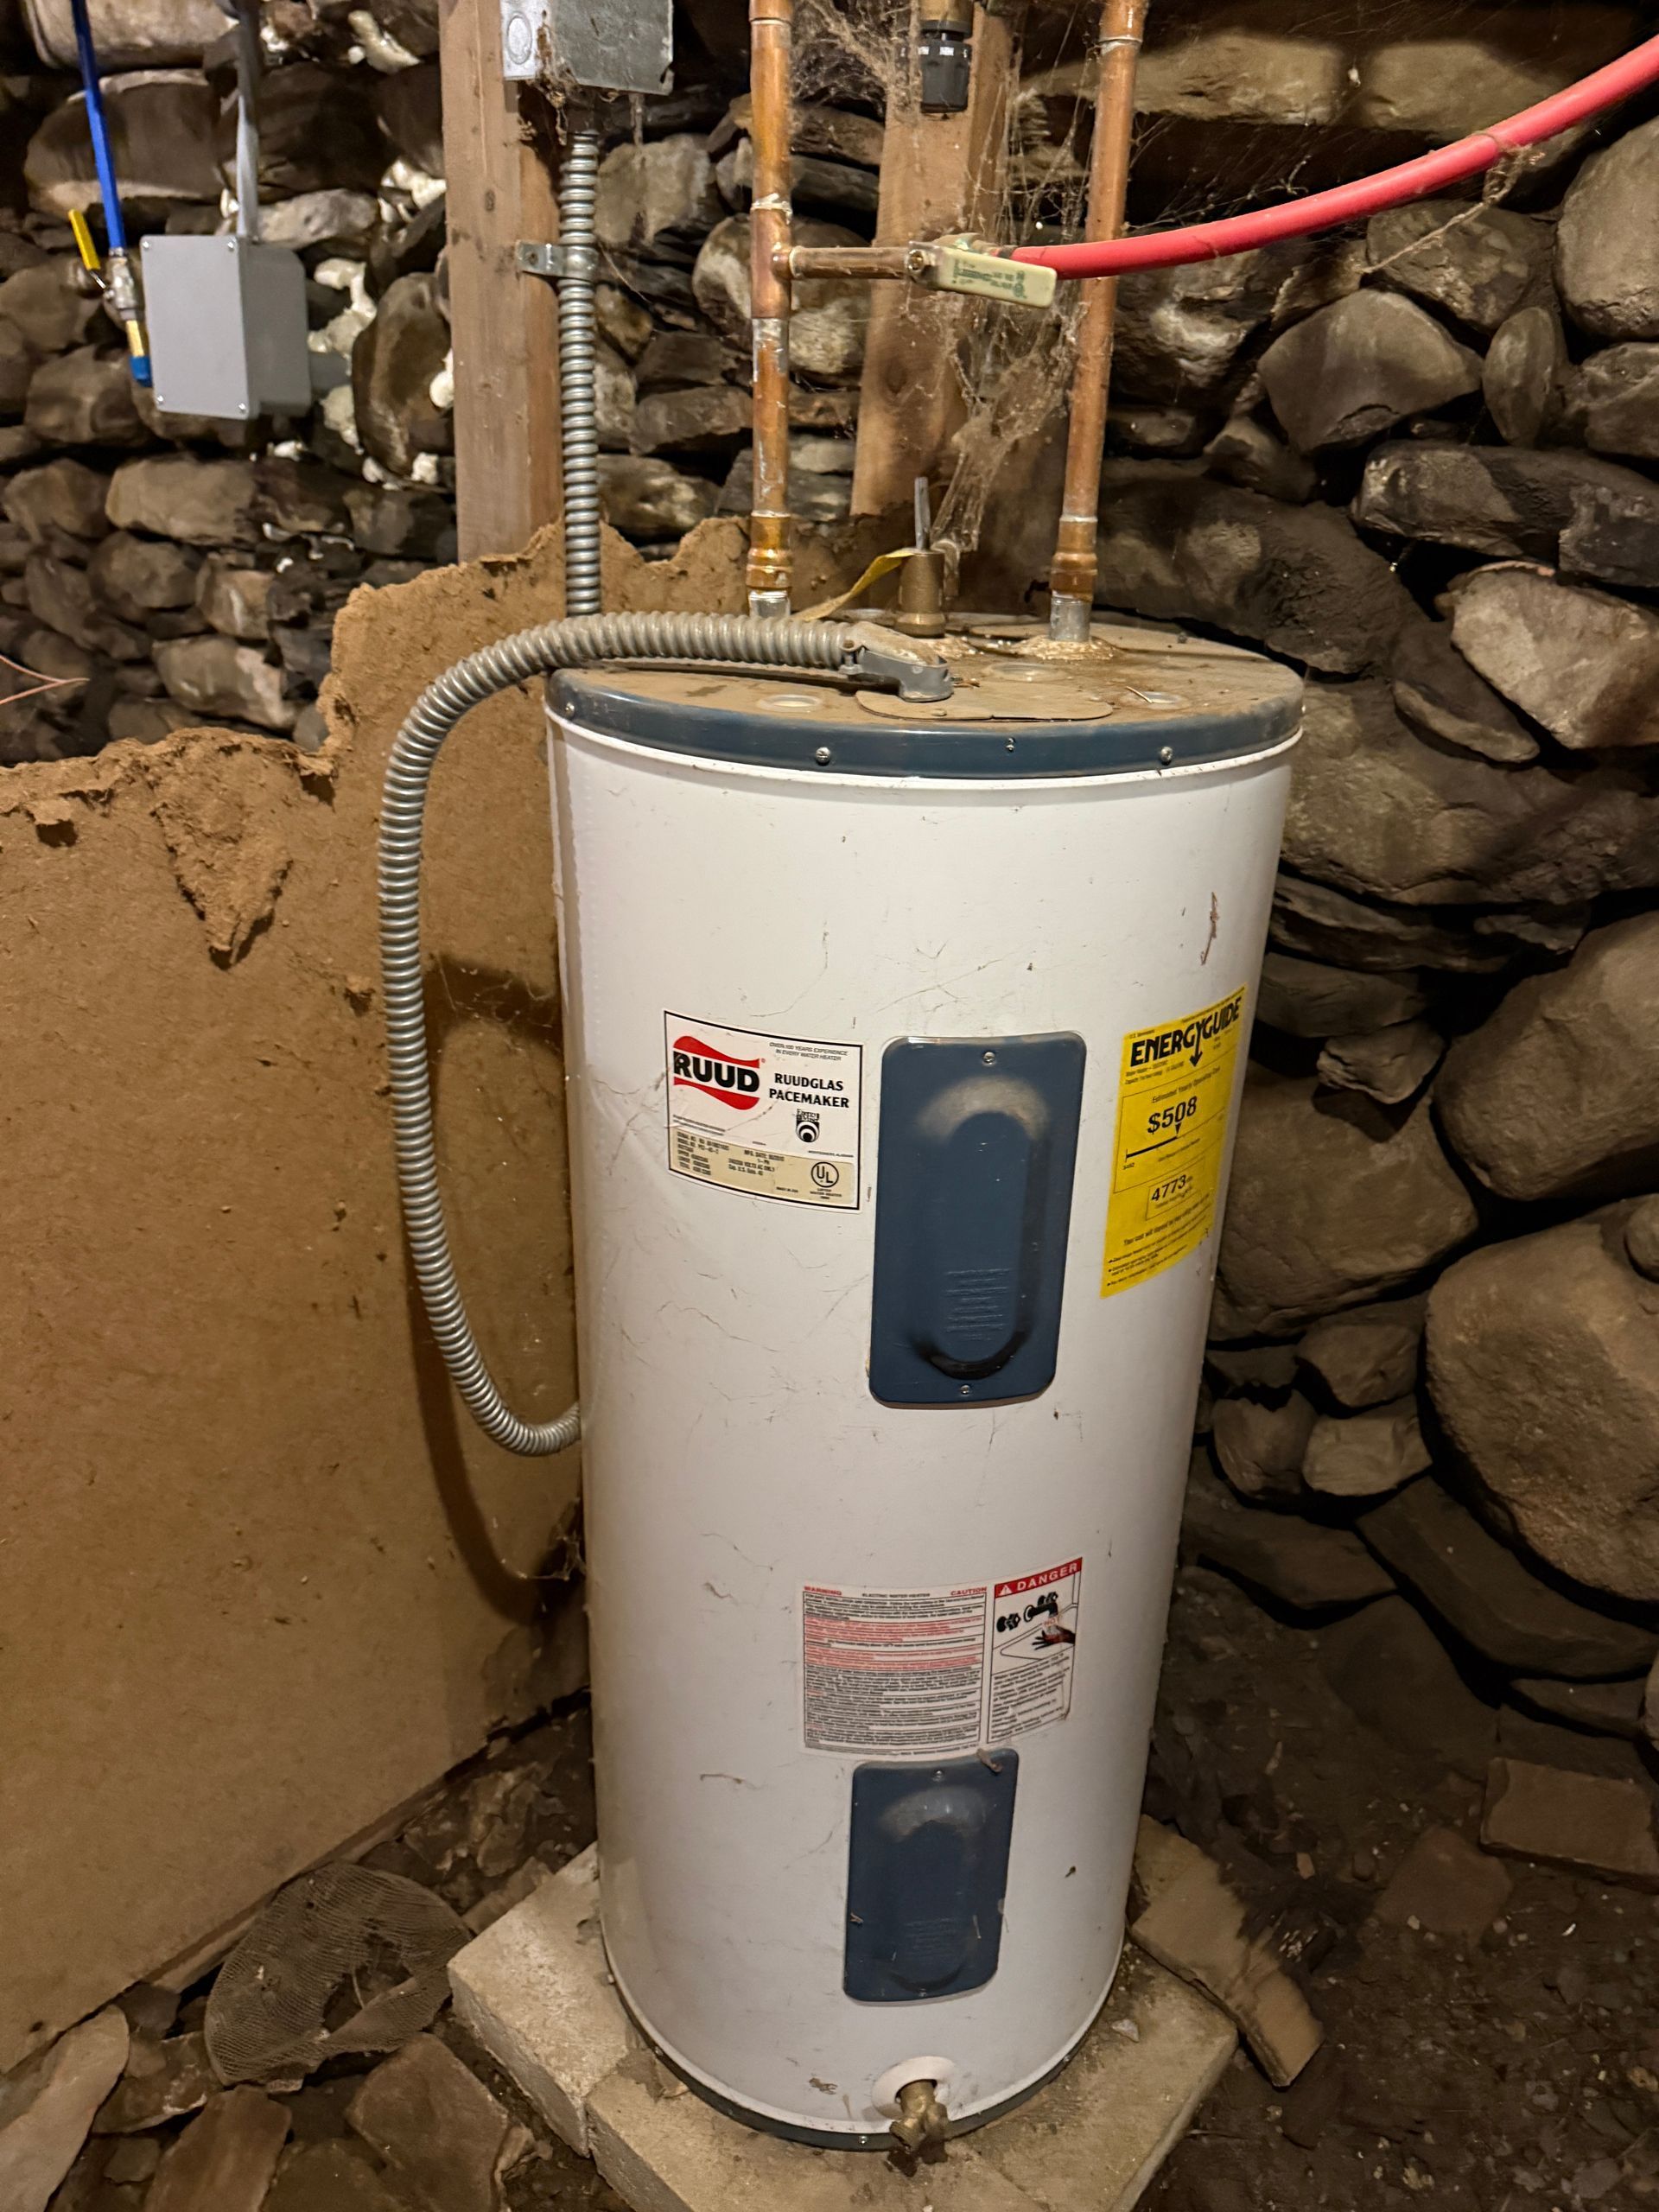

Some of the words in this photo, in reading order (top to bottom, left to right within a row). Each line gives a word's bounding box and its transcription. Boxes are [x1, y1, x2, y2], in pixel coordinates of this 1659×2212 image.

[1130, 996, 1242, 1067] ENERGYGUIDE
[673, 1051, 760, 1092] RUUD
[774, 1072, 843, 1091] RUUDGLAS
[769, 1088, 849, 1108] PACEMAKER
[1147, 1096, 1198, 1135] $508
[817, 1166, 833, 1184] UL
[1151, 1174, 1186, 1202] 4773
[1018, 1562, 1077, 1591] DANGER
[950, 1586, 987, 1596] CAUTION
